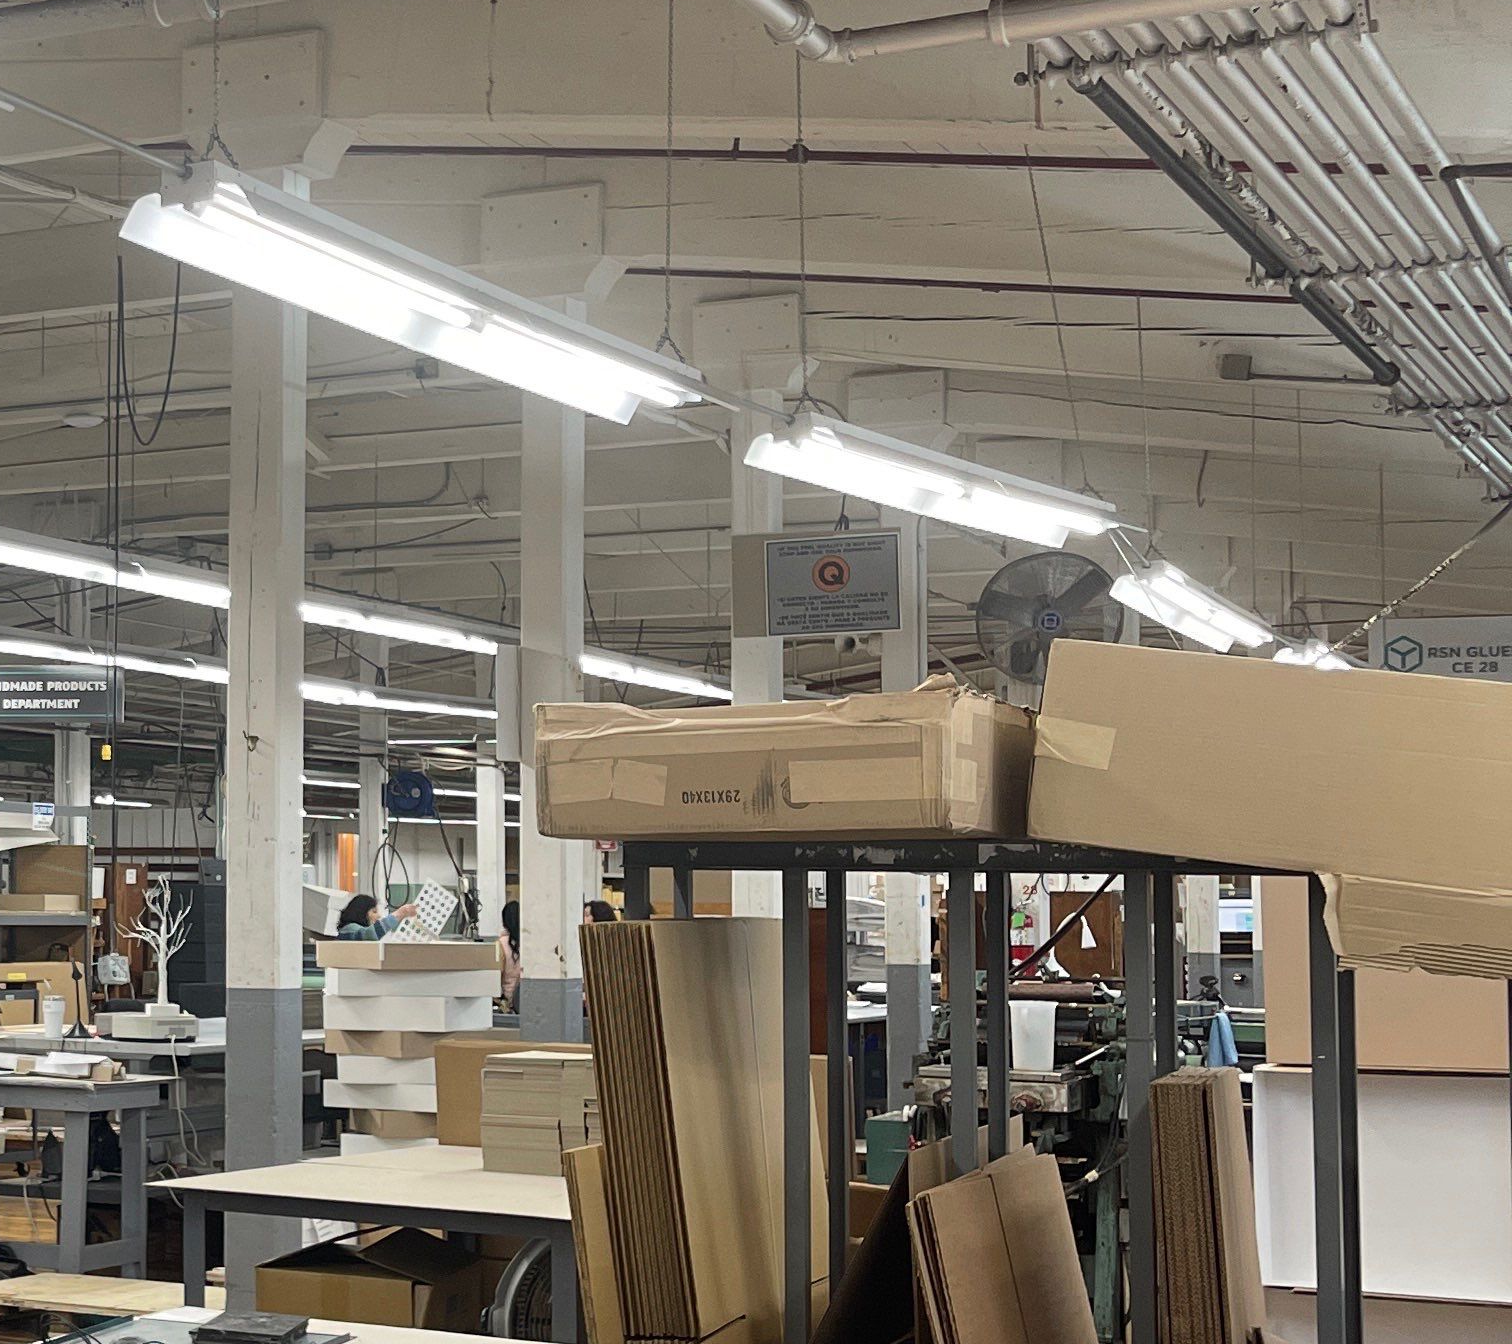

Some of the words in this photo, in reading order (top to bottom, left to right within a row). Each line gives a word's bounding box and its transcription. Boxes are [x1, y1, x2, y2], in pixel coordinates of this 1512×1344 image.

[819, 561, 844, 586] Q
[1428, 647, 1461, 658] RSN
[1452, 662, 1474, 673] CE
[1479, 661, 1499, 673] 28
[47, 681, 108, 692] PRODUCTS
[2, 699, 81, 709] DEPARTMENT
[682, 790, 741, 804] 29X13X40
